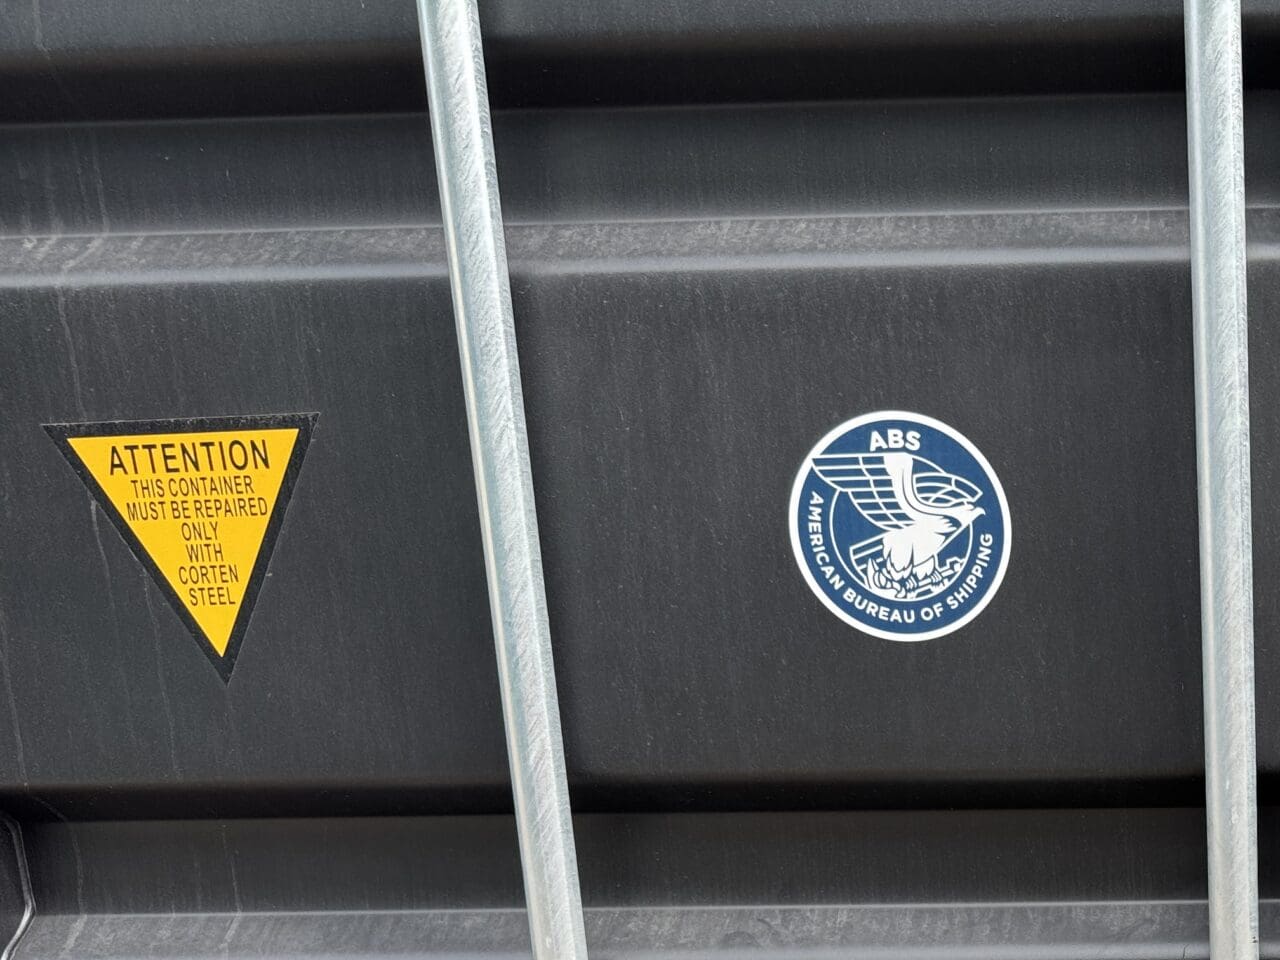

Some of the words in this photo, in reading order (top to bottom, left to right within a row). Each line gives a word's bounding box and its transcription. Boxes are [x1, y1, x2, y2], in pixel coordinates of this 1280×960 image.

[869, 429, 921, 451] ABS
[110, 440, 270, 475] ATTENTION
[131, 479, 164, 498] THIS
[169, 475, 255, 497] CONTAINER
[127, 501, 167, 521] MUST
[171, 500, 190, 519] BE
[195, 497, 268, 518] REPAIRED
[181, 521, 219, 541] ONLY
[185, 544, 223, 562] WITH
[808, 491, 845, 591] AMERICAN
[843, 588, 915, 623] BUREAU
[920, 603, 944, 621] OF
[946, 533, 994, 610] SHIPPING
[179, 565, 239, 585] CORTEN
[189, 587, 236, 606] STEEL
